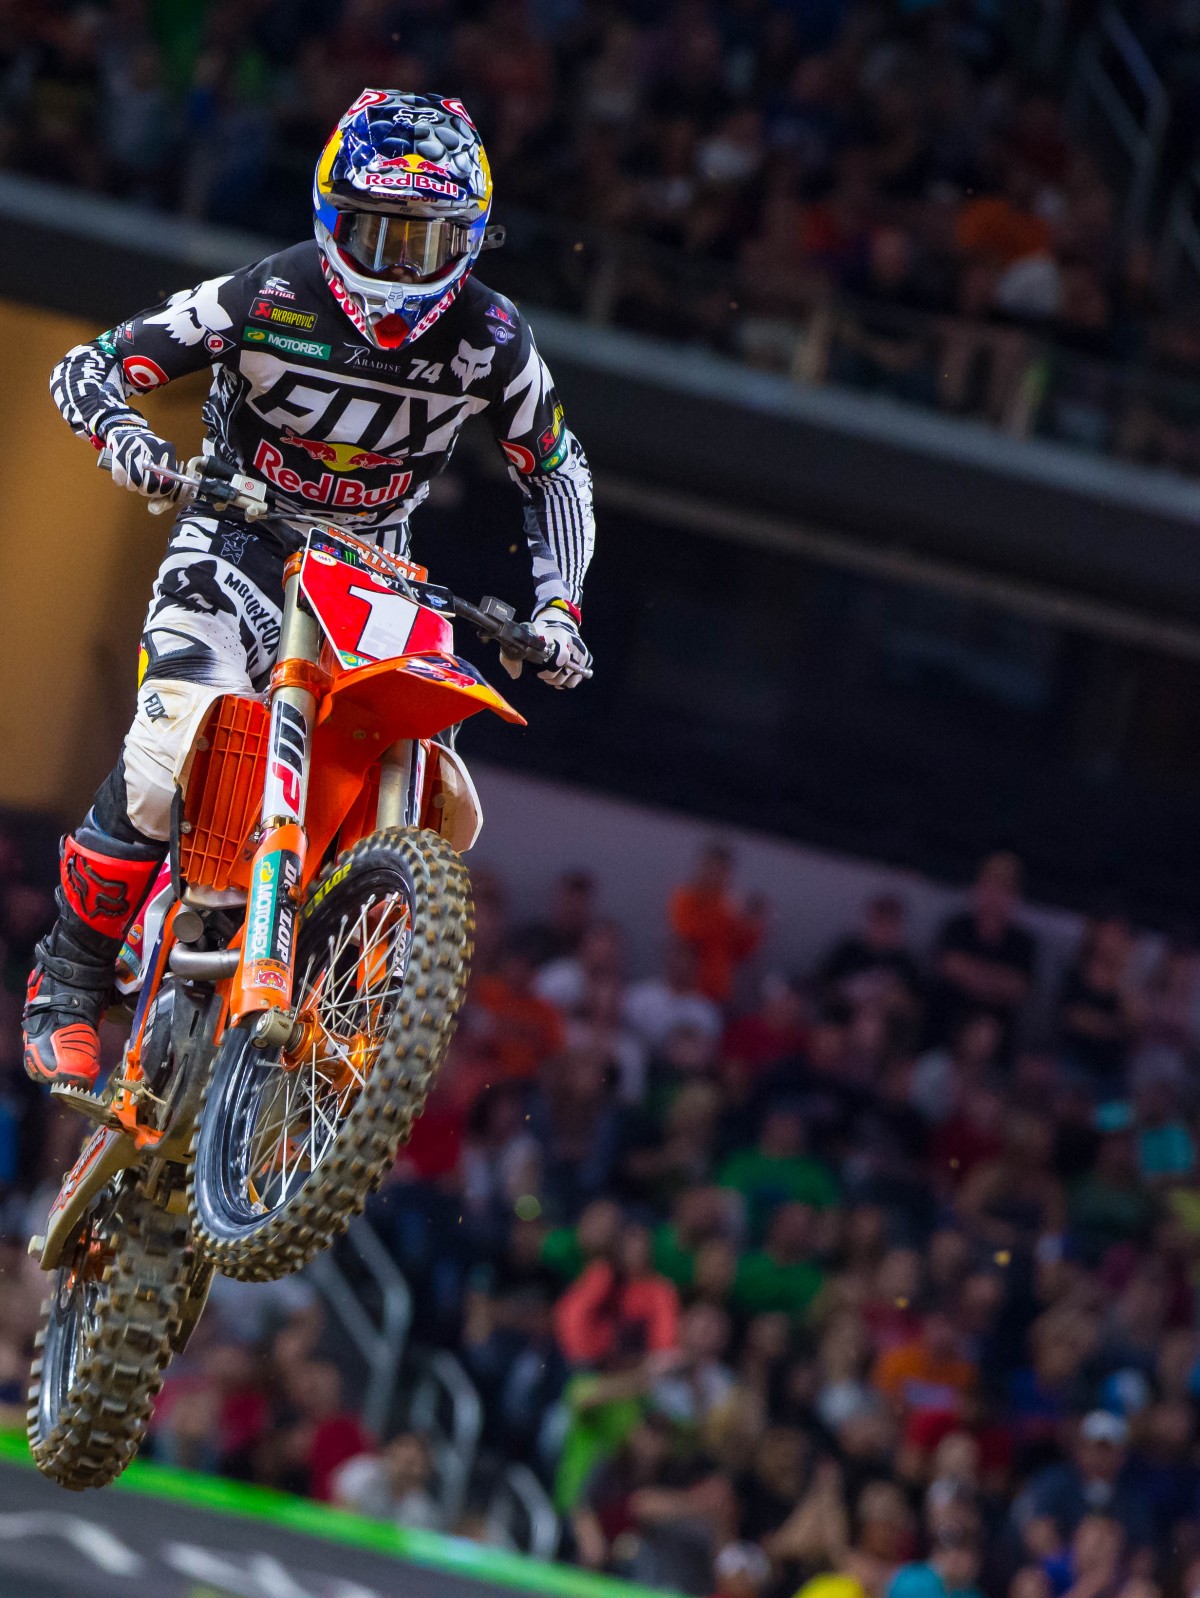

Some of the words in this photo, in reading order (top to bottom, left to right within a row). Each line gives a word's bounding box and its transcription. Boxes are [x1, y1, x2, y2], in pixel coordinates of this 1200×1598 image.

[365, 172, 412, 187] Red
[414, 173, 458, 198] Bull
[258, 288, 296, 300] RENTHAL
[268, 333, 325, 357] MOTOREX
[342, 341, 401, 373] PARADISE
[406, 358, 445, 384] 74
[251, 369, 471, 456] FOX
[253, 438, 334, 504] Red
[331, 470, 413, 508] Bull
[347, 583, 420, 661] 1
[144, 692, 169, 724] FOX
[250, 883, 274, 957] MOTOREX
[276, 859, 298, 964] DLOP
